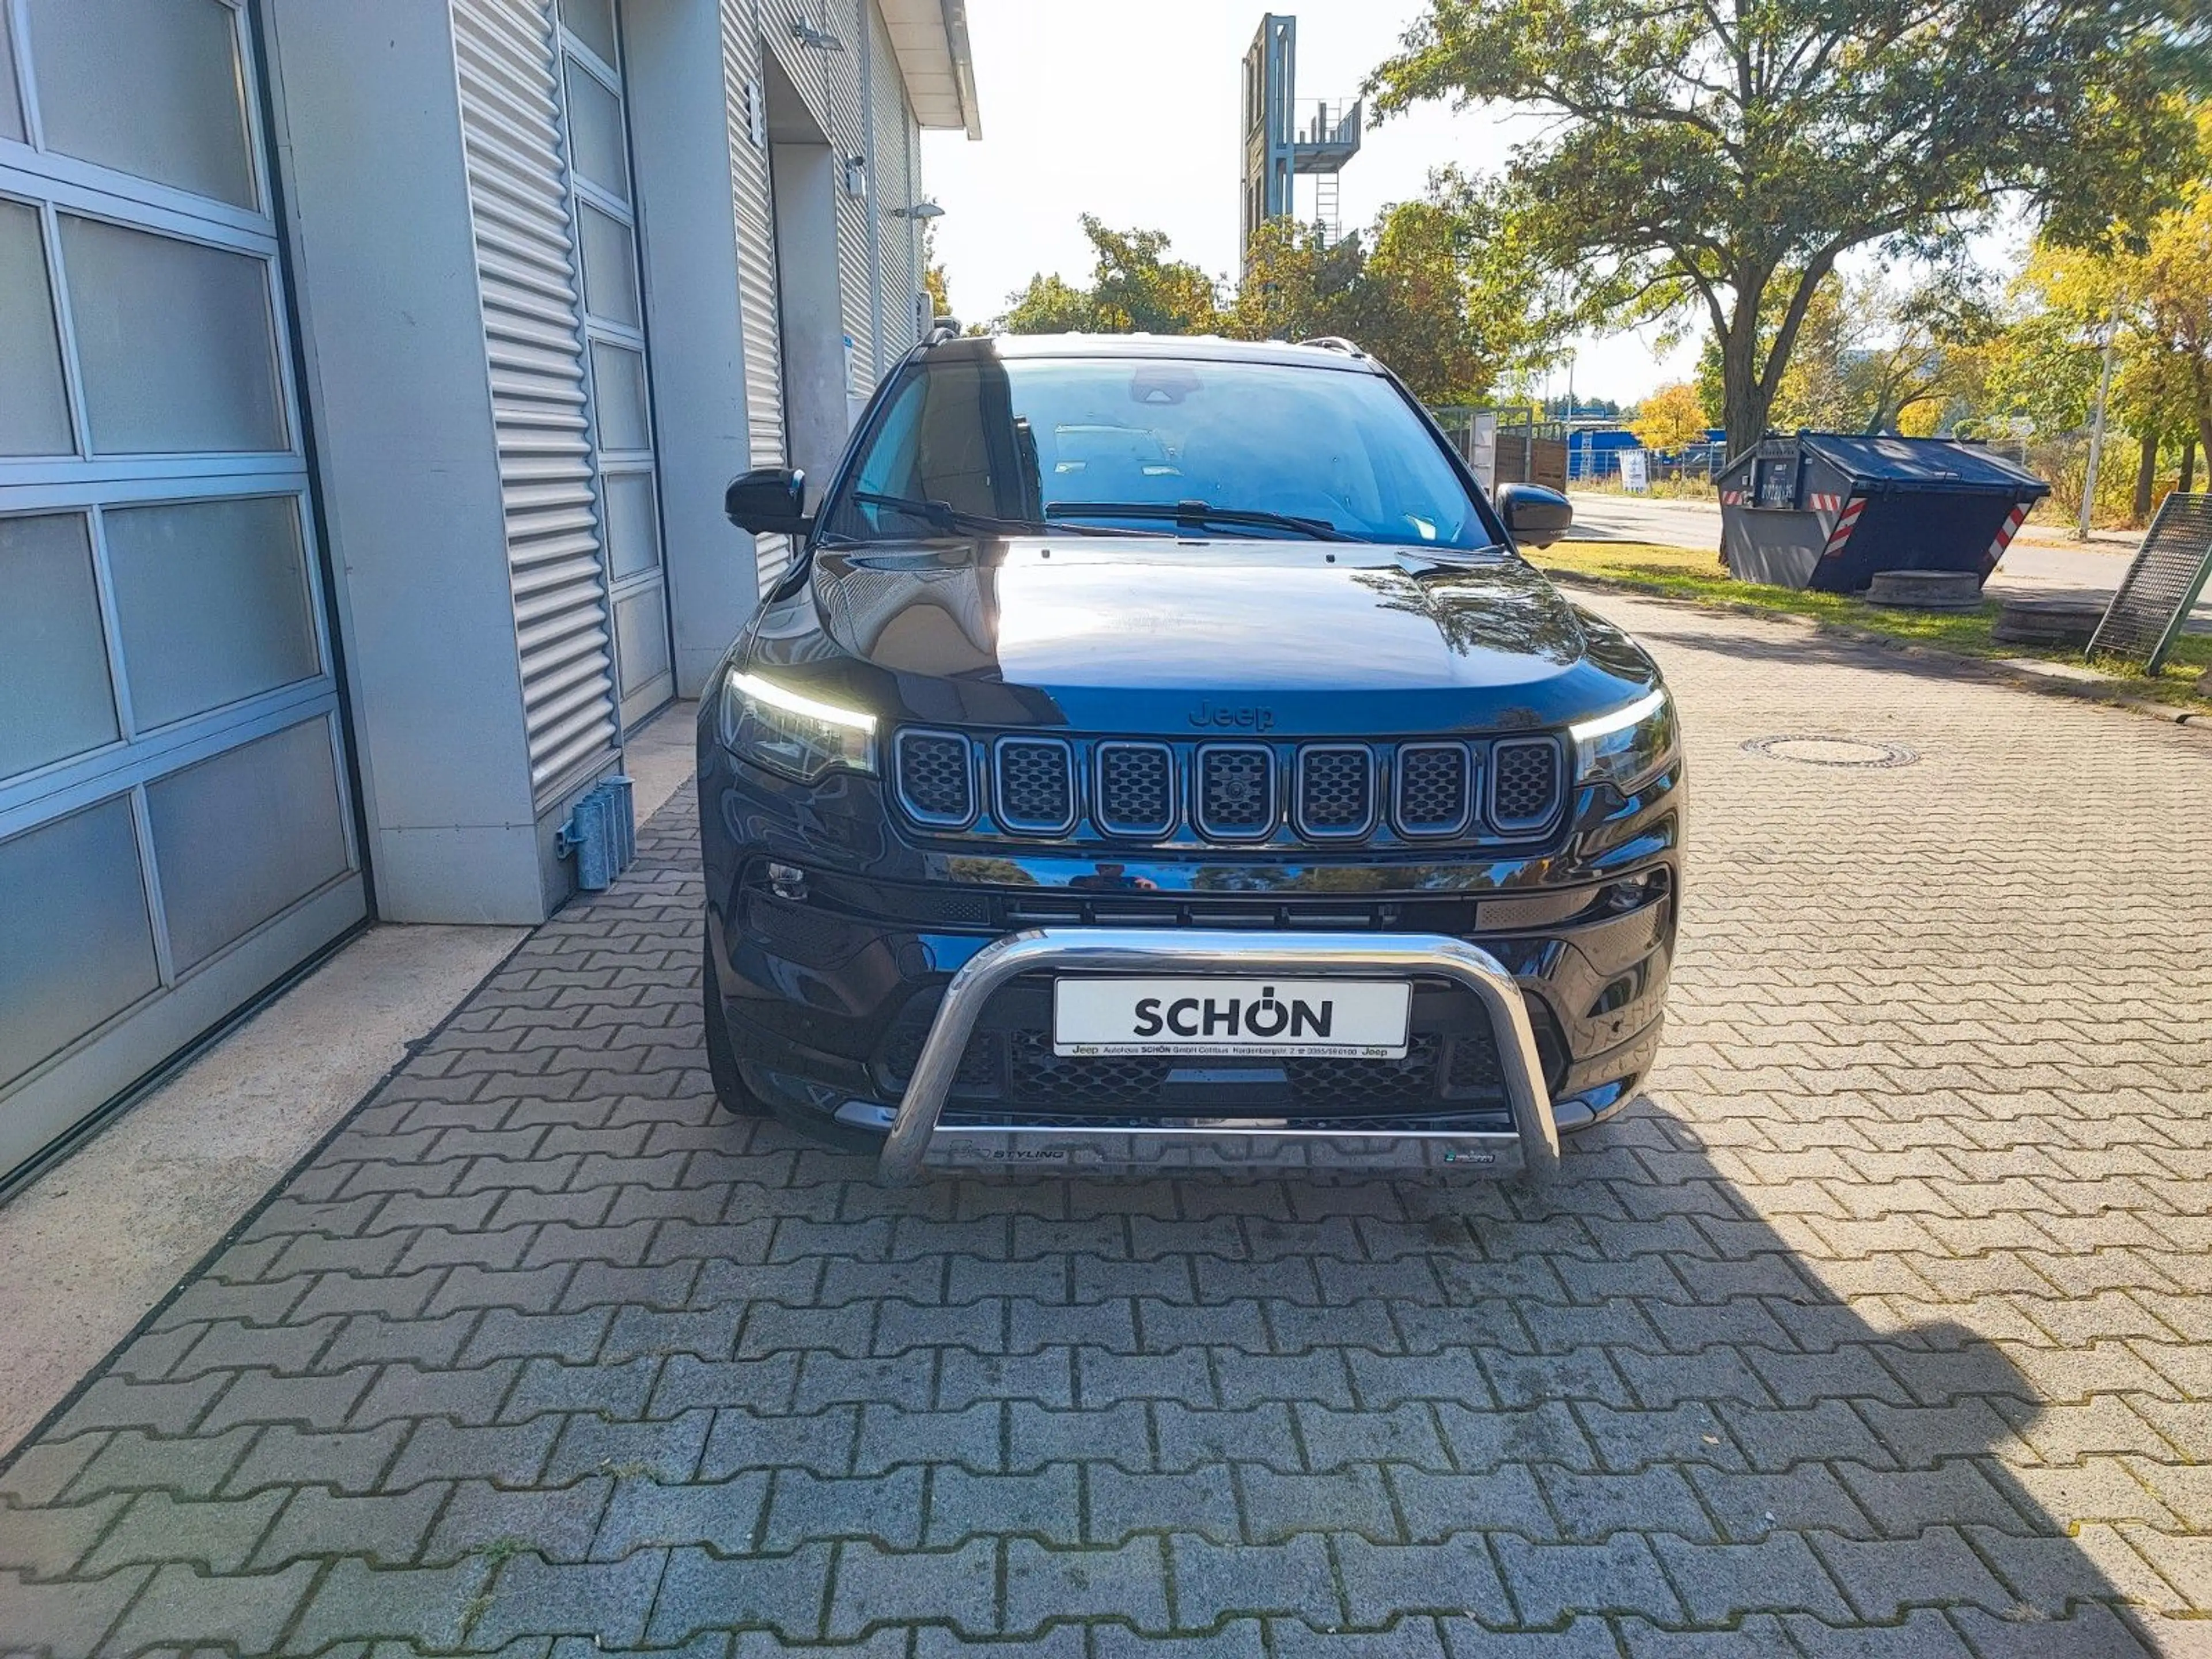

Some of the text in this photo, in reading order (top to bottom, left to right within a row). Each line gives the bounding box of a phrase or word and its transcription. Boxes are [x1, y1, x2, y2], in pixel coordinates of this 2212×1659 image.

[1188, 699, 1275, 732] Jeep
[1133, 986, 1333, 1037] SCHÖN
[1073, 1045, 1099, 1054] Jeep
[1141, 1046, 1171, 1054] SCHÖN
[1362, 1047, 1387, 1057] Jeep
